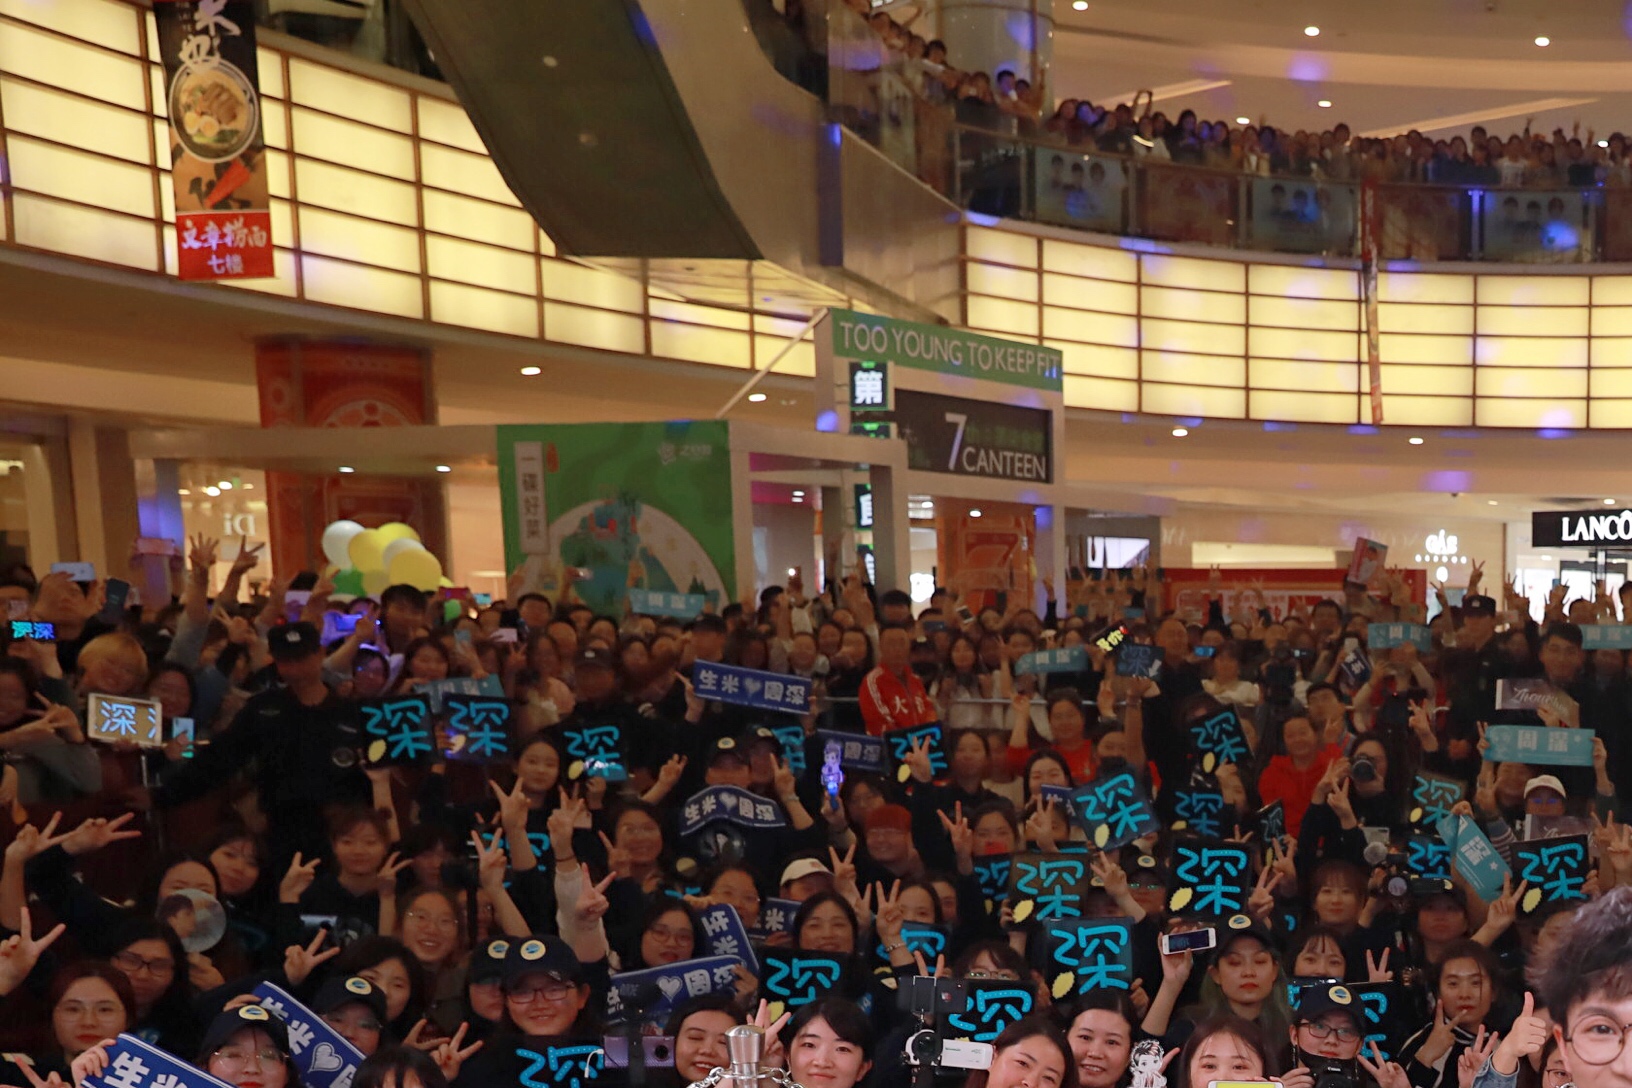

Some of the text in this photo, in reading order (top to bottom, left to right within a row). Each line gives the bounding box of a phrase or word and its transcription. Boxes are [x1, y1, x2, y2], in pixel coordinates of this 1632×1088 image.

[181, 218, 267, 250] 文章捞面
[840, 322, 1061, 379] TOO YOUNG TO KEEP FIT
[854, 370, 883, 404] 第
[945, 412, 967, 470] 7
[962, 447, 1046, 479] CANTEEN
[698, 669, 806, 706] 生米 周深
[361, 699, 433, 759] 深
[449, 700, 509, 757] 深
[1190, 711, 1247, 764] 深
[1075, 773, 1151, 839] 深
[1174, 781, 1224, 838] 深
[1016, 860, 1083, 921] 深
[1176, 847, 1248, 915] 深
[1517, 842, 1589, 901] 深
[1051, 924, 1130, 995] 深
